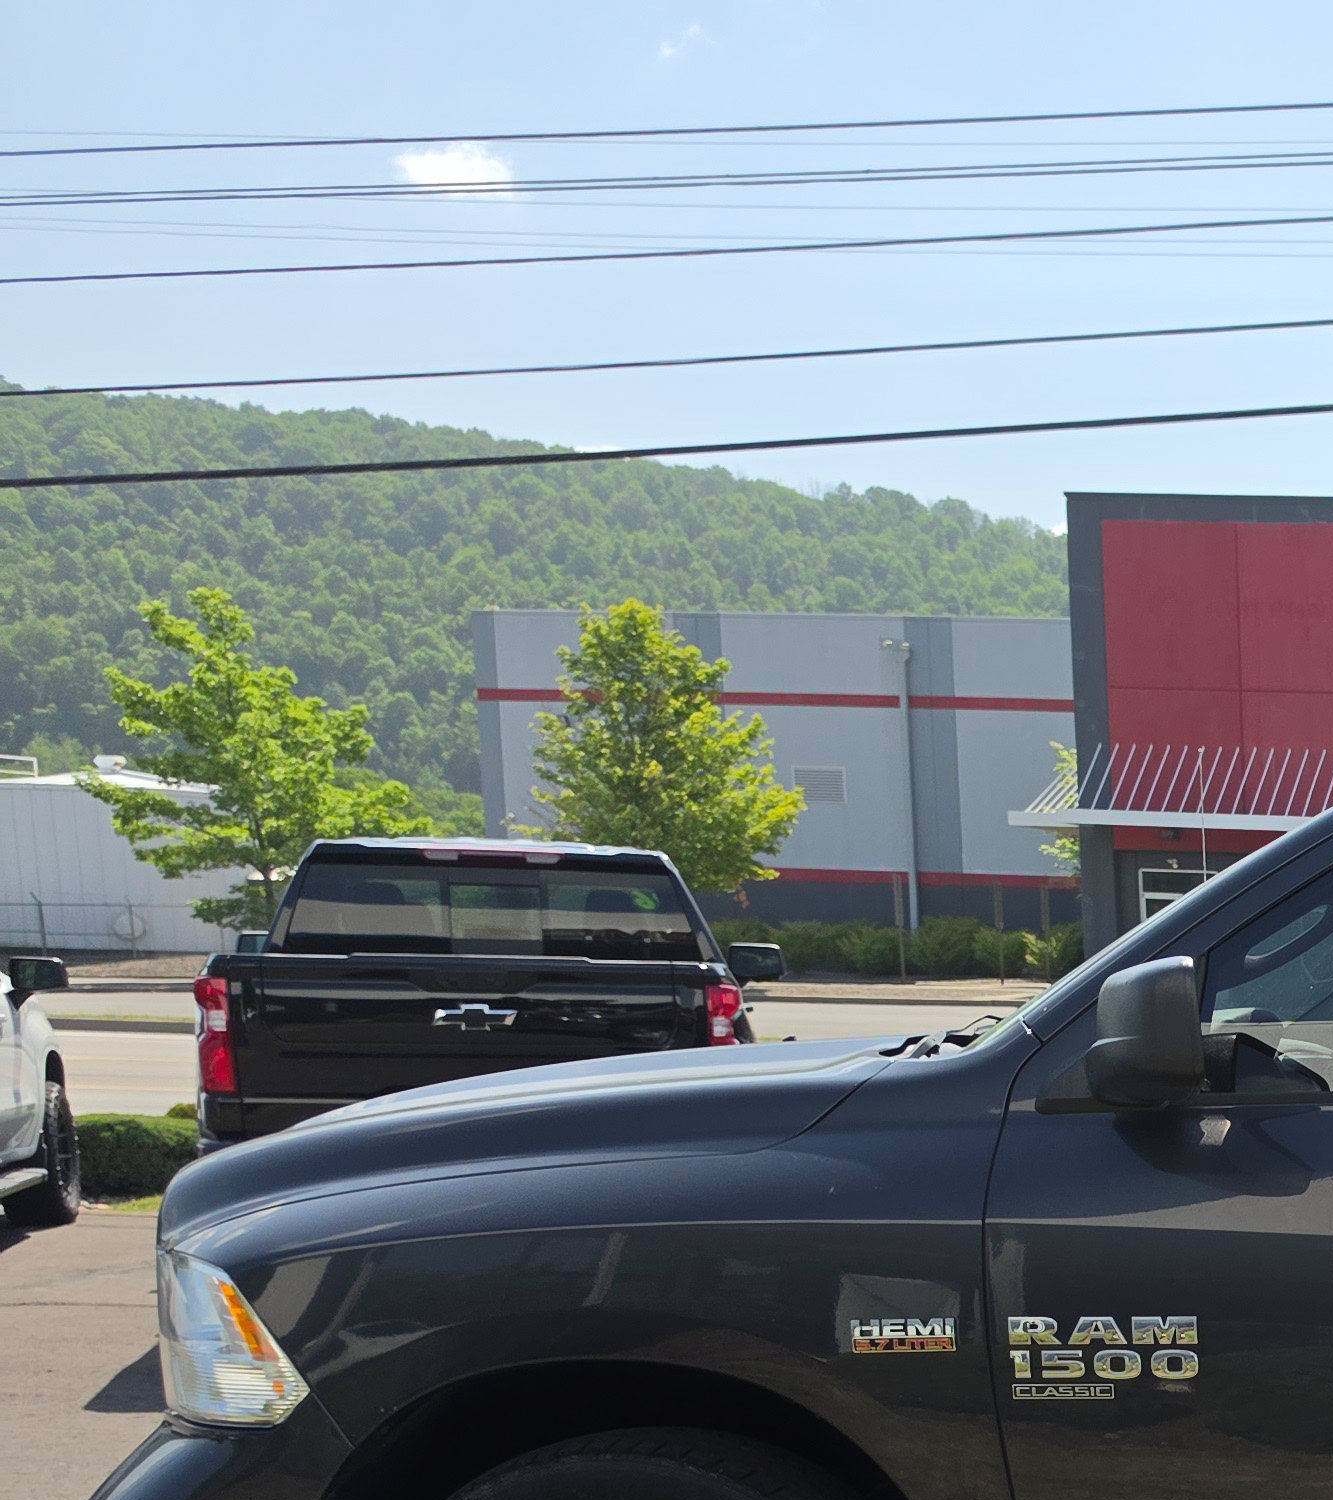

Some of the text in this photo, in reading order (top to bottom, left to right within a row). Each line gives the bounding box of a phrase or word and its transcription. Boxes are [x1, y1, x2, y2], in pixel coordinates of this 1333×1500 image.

[850, 1317, 955, 1337] HEMI
[1007, 1315, 1199, 1345] RAM
[855, 1337, 953, 1351] 5.7 LITER
[1009, 1348, 1199, 1380] 1500
[1015, 1385, 1112, 1398] CLASSIC
